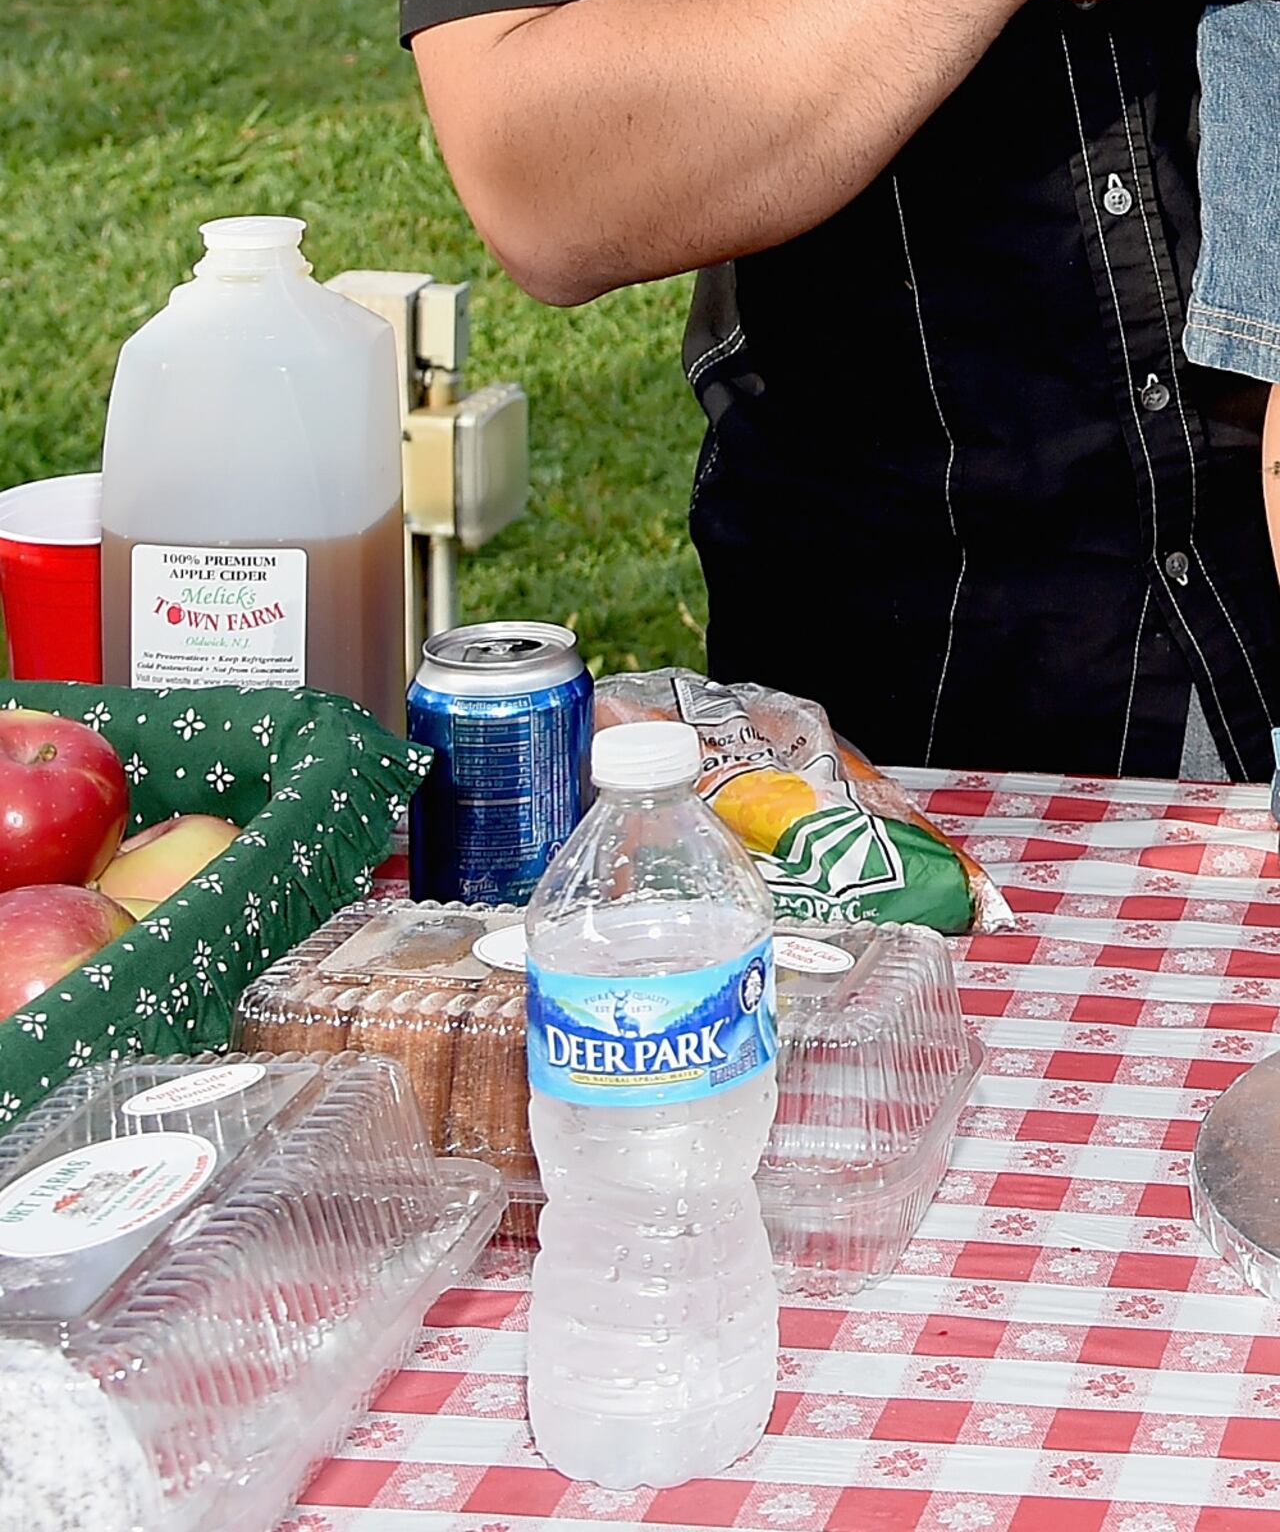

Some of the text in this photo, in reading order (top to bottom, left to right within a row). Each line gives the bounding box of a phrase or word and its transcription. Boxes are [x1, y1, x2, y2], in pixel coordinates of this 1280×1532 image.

[162, 553, 277, 567] 100% PREMIUM
[169, 568, 267, 581] APPLE CIDER
[153, 596, 286, 632] TOWN FARM
[545, 1024, 633, 1073] DEER
[634, 1018, 727, 1072] PARK
[29, 1160, 92, 1197] FARMS
